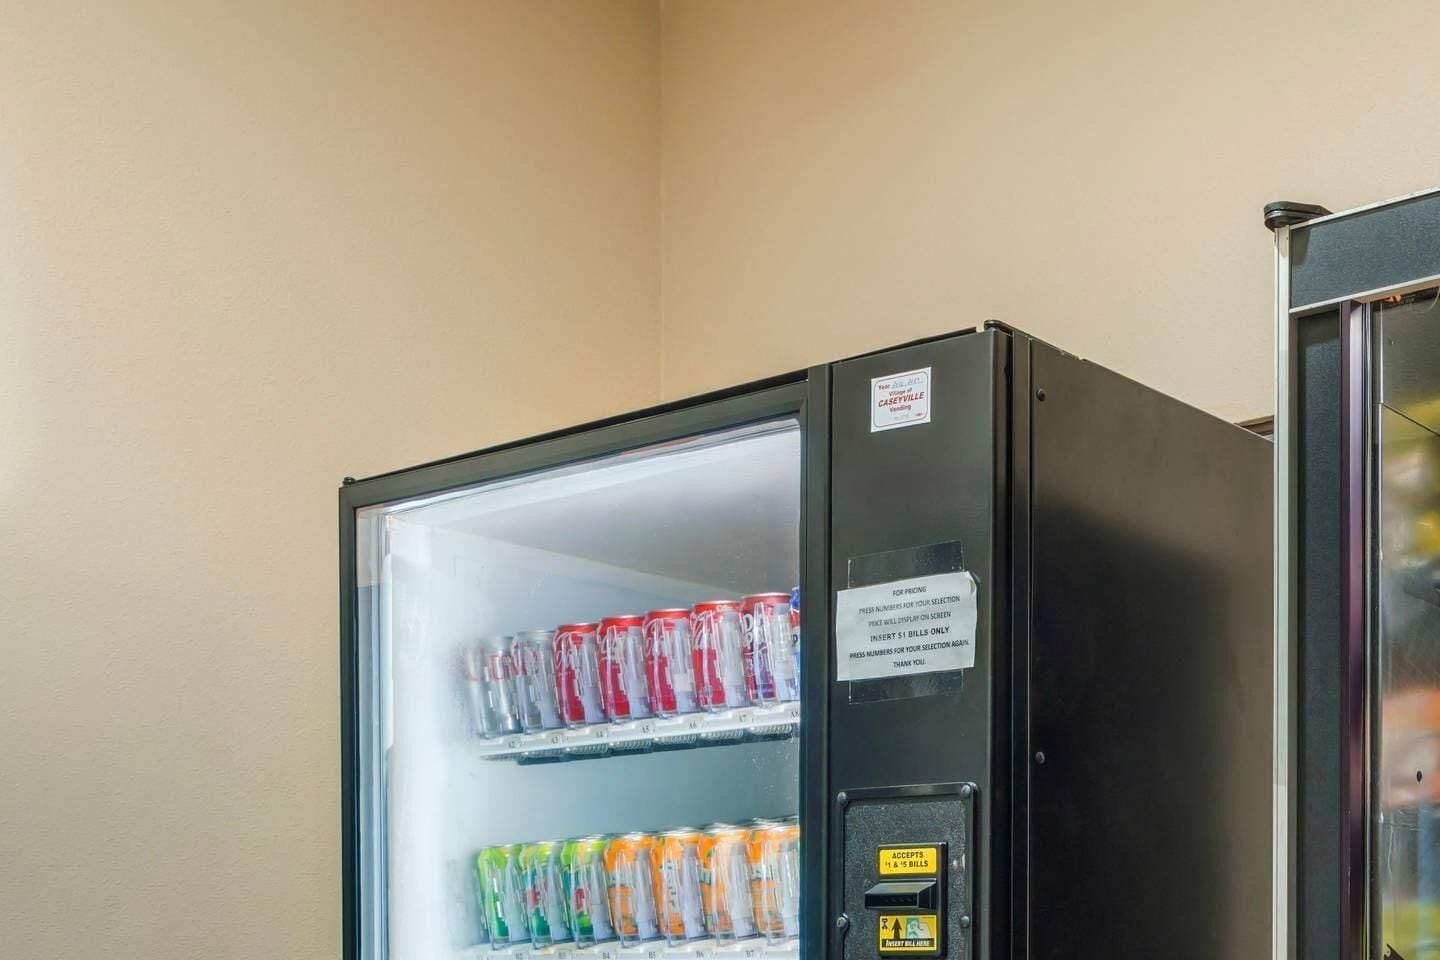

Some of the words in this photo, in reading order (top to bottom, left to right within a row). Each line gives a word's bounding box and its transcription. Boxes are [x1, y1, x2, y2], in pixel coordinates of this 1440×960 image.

[878, 391, 925, 407] CASEYVILLE
[889, 404, 912, 413] Vending
[892, 589, 904, 597] FOR
[904, 586, 927, 595] PRICING
[858, 606, 875, 615] PRESS
[875, 603, 902, 613] NUMBERS
[902, 601, 915, 609] FOR
[915, 600, 930, 608] YOUR
[931, 595, 961, 605] SELECTION
[883, 618, 898, 626] WILL
[898, 615, 919, 625] DISPLAY
[920, 613, 930, 621] ON
[930, 611, 951, 620] SCREEN
[870, 633, 896, 642] INSERT
[898, 631, 906, 639] $1
[908, 629, 929, 638] BILLS
[930, 626, 950, 635] ONLY
[849, 651, 866, 659] PRESS
[866, 648, 893, 657] NUMBERS
[893, 646, 905, 654] FOR
[905, 645, 921, 653] YOUR
[921, 642, 951, 650] SELECTION
[951, 639, 970, 648] AGAIN.
[893, 660, 913, 668] THANK
[913, 659, 926, 667] YOU.
[892, 851, 924, 860] ACCEPTS
[893, 861, 899, 869] &
[908, 860, 929, 868] BILLS
[885, 939, 905, 948] INSERT
[916, 940, 931, 948] HERE
